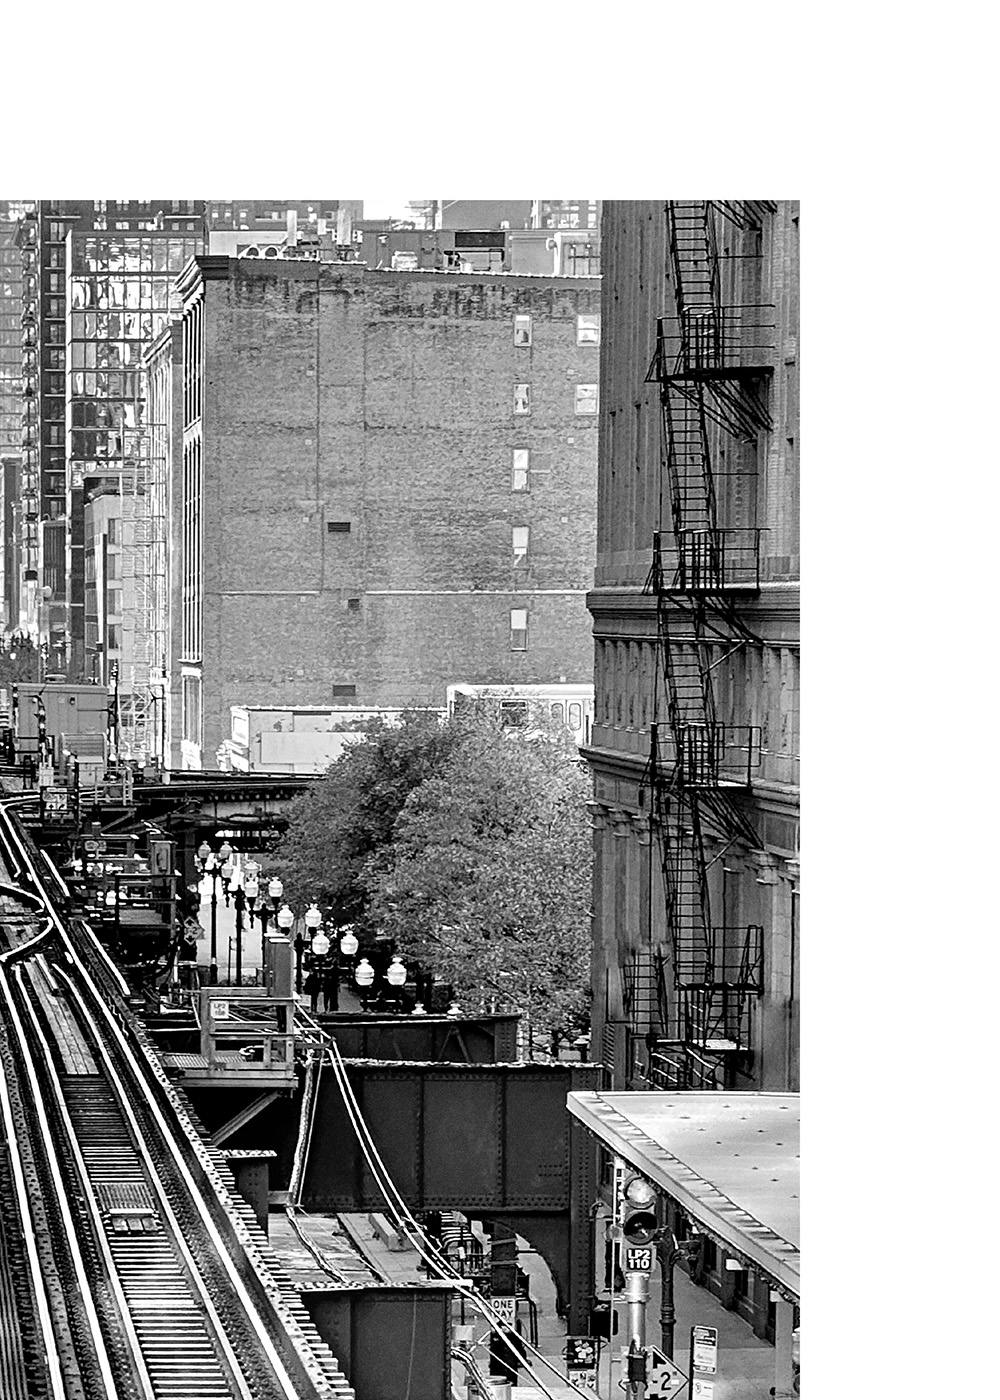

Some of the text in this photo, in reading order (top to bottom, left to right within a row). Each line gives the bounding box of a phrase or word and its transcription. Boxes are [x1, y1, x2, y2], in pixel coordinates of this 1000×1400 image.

[627, 1249, 651, 1259] LP2
[628, 1259, 650, 1269] 110
[493, 1299, 513, 1309] ONE
